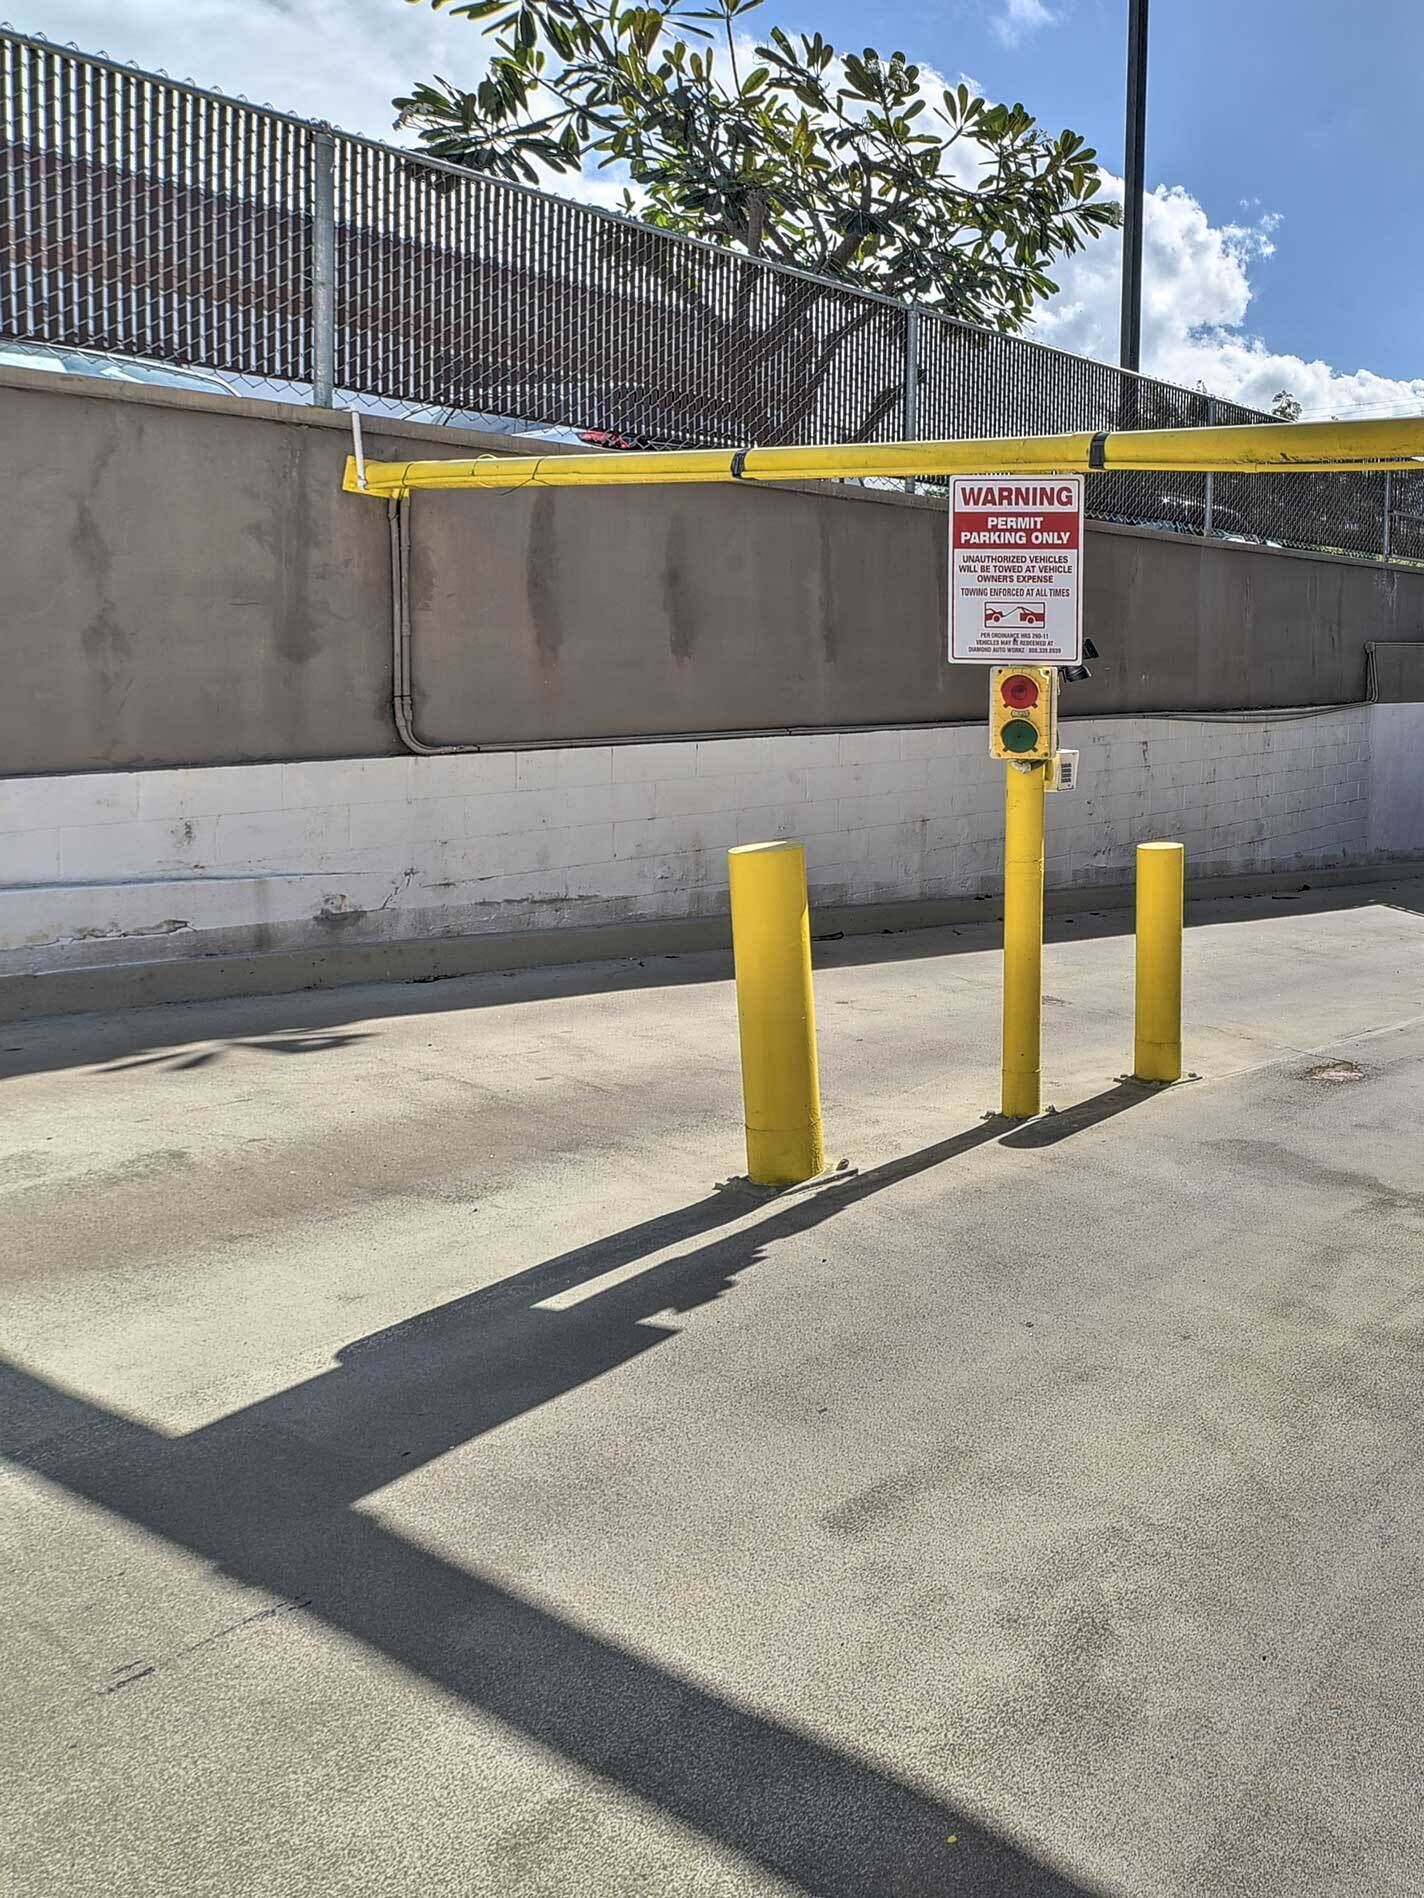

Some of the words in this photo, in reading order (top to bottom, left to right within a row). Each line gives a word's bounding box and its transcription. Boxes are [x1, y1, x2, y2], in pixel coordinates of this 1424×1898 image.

[960, 486, 1073, 506] WARNING
[987, 517, 1043, 529] PERMIT
[960, 532, 1026, 544] PARKING
[1031, 532, 1070, 545] ONLY
[962, 555, 1027, 564] UNAUTHORIZED
[1029, 555, 1069, 564] VEHICLES
[959, 565, 978, 573] WILL
[980, 565, 990, 573] BE
[993, 565, 1023, 574] TOWED
[1025, 565, 1036, 574] AT
[1039, 565, 1073, 574] VEHICLE
[1016, 575, 1054, 583] EXPENSE
[961, 588, 988, 596] TOWING
[990, 588, 1024, 597] ENFORCED
[1026, 588, 1036, 597] AT
[1036, 588, 1048, 597] ALL
[1049, 588, 1070, 597] TIMES
